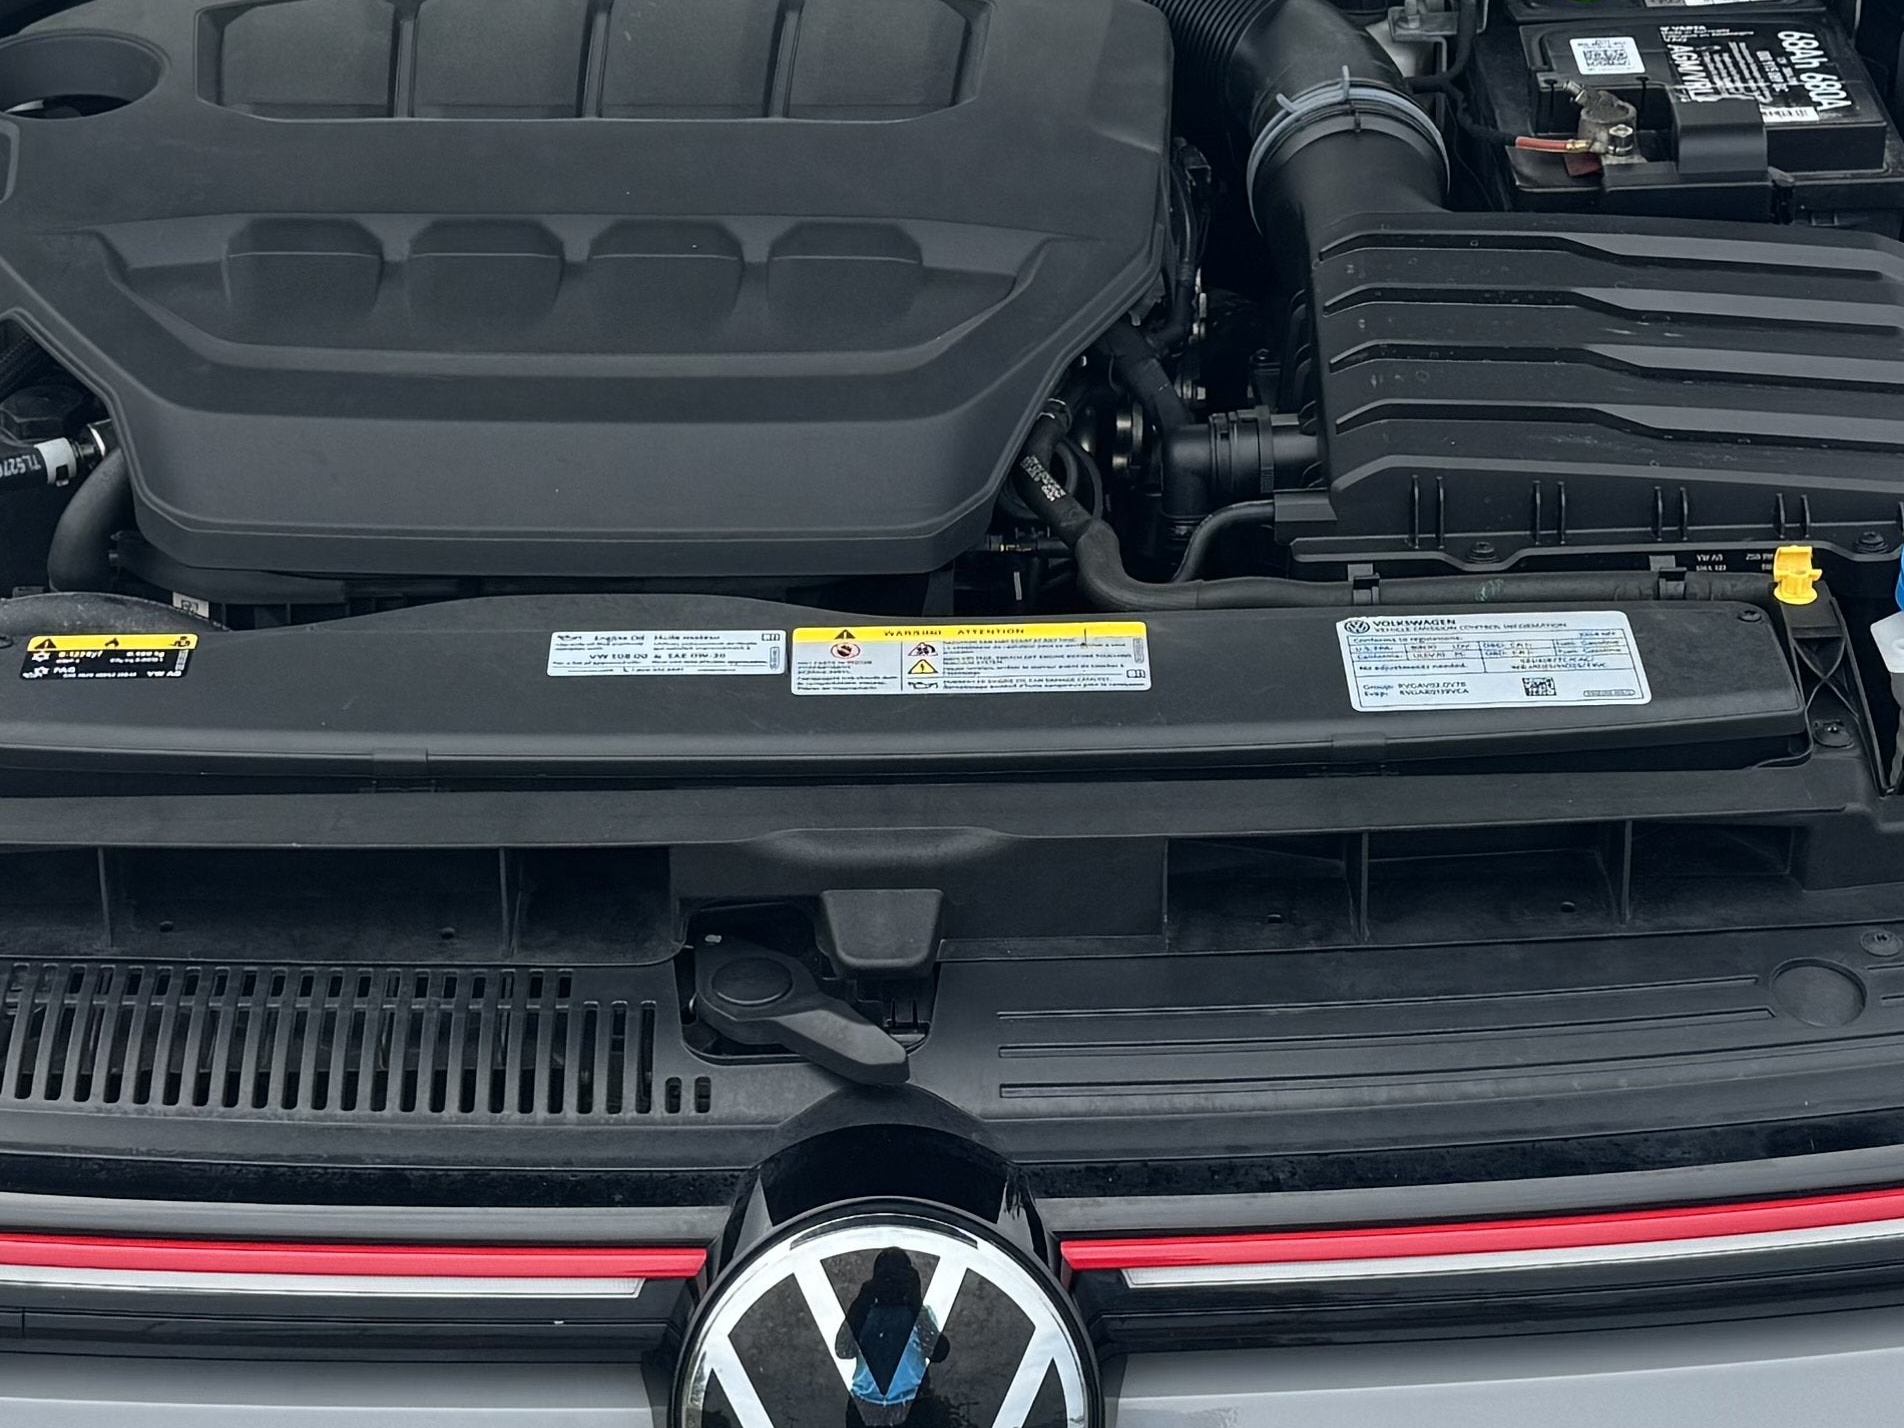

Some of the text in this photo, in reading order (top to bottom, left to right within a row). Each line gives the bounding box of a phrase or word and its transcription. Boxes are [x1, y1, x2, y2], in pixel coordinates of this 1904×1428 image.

[1777, 30, 1829, 69] 68Ah
[1799, 72, 1852, 111] 680A
[884, 627, 1024, 638] WARNING ATTENTION
[1373, 618, 1456, 627] VOLKSWAGEN
